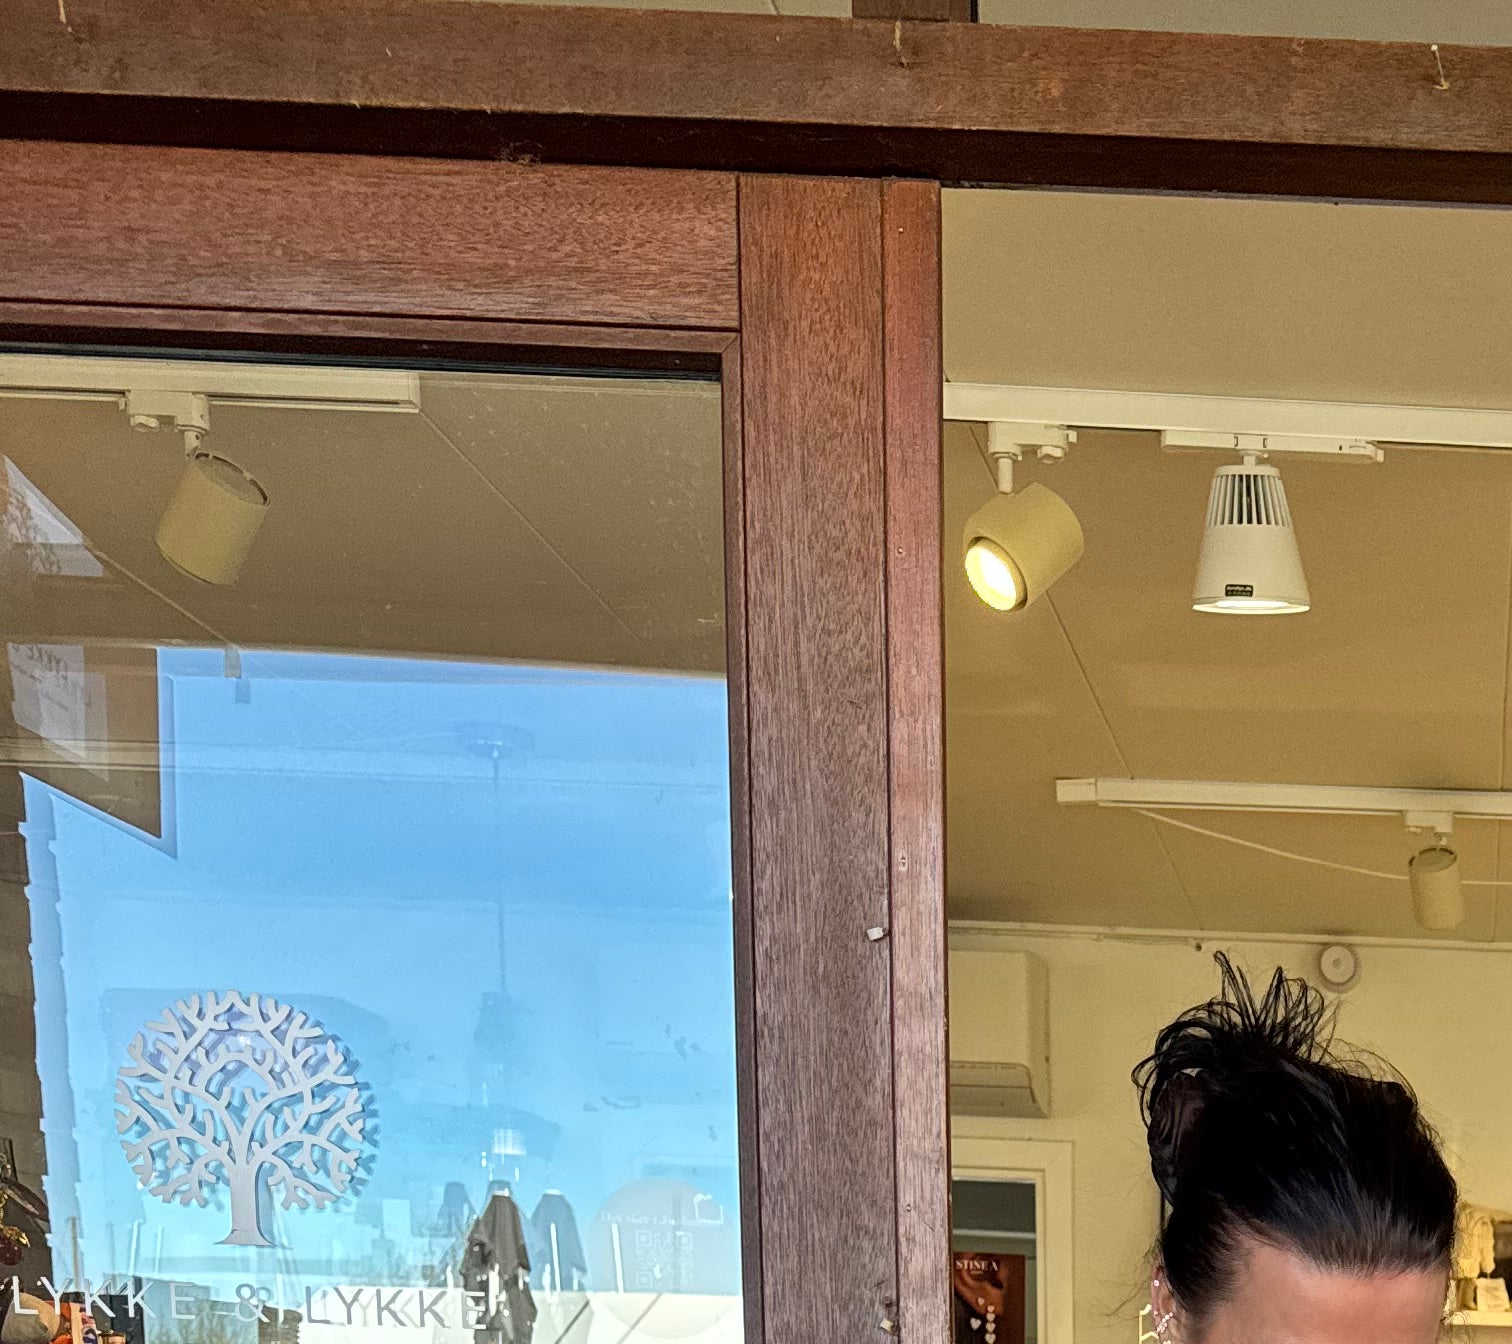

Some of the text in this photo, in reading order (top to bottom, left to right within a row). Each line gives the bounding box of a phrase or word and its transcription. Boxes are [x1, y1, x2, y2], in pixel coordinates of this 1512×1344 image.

[12, 1276, 487, 1330] LYKKE & LYKKE
